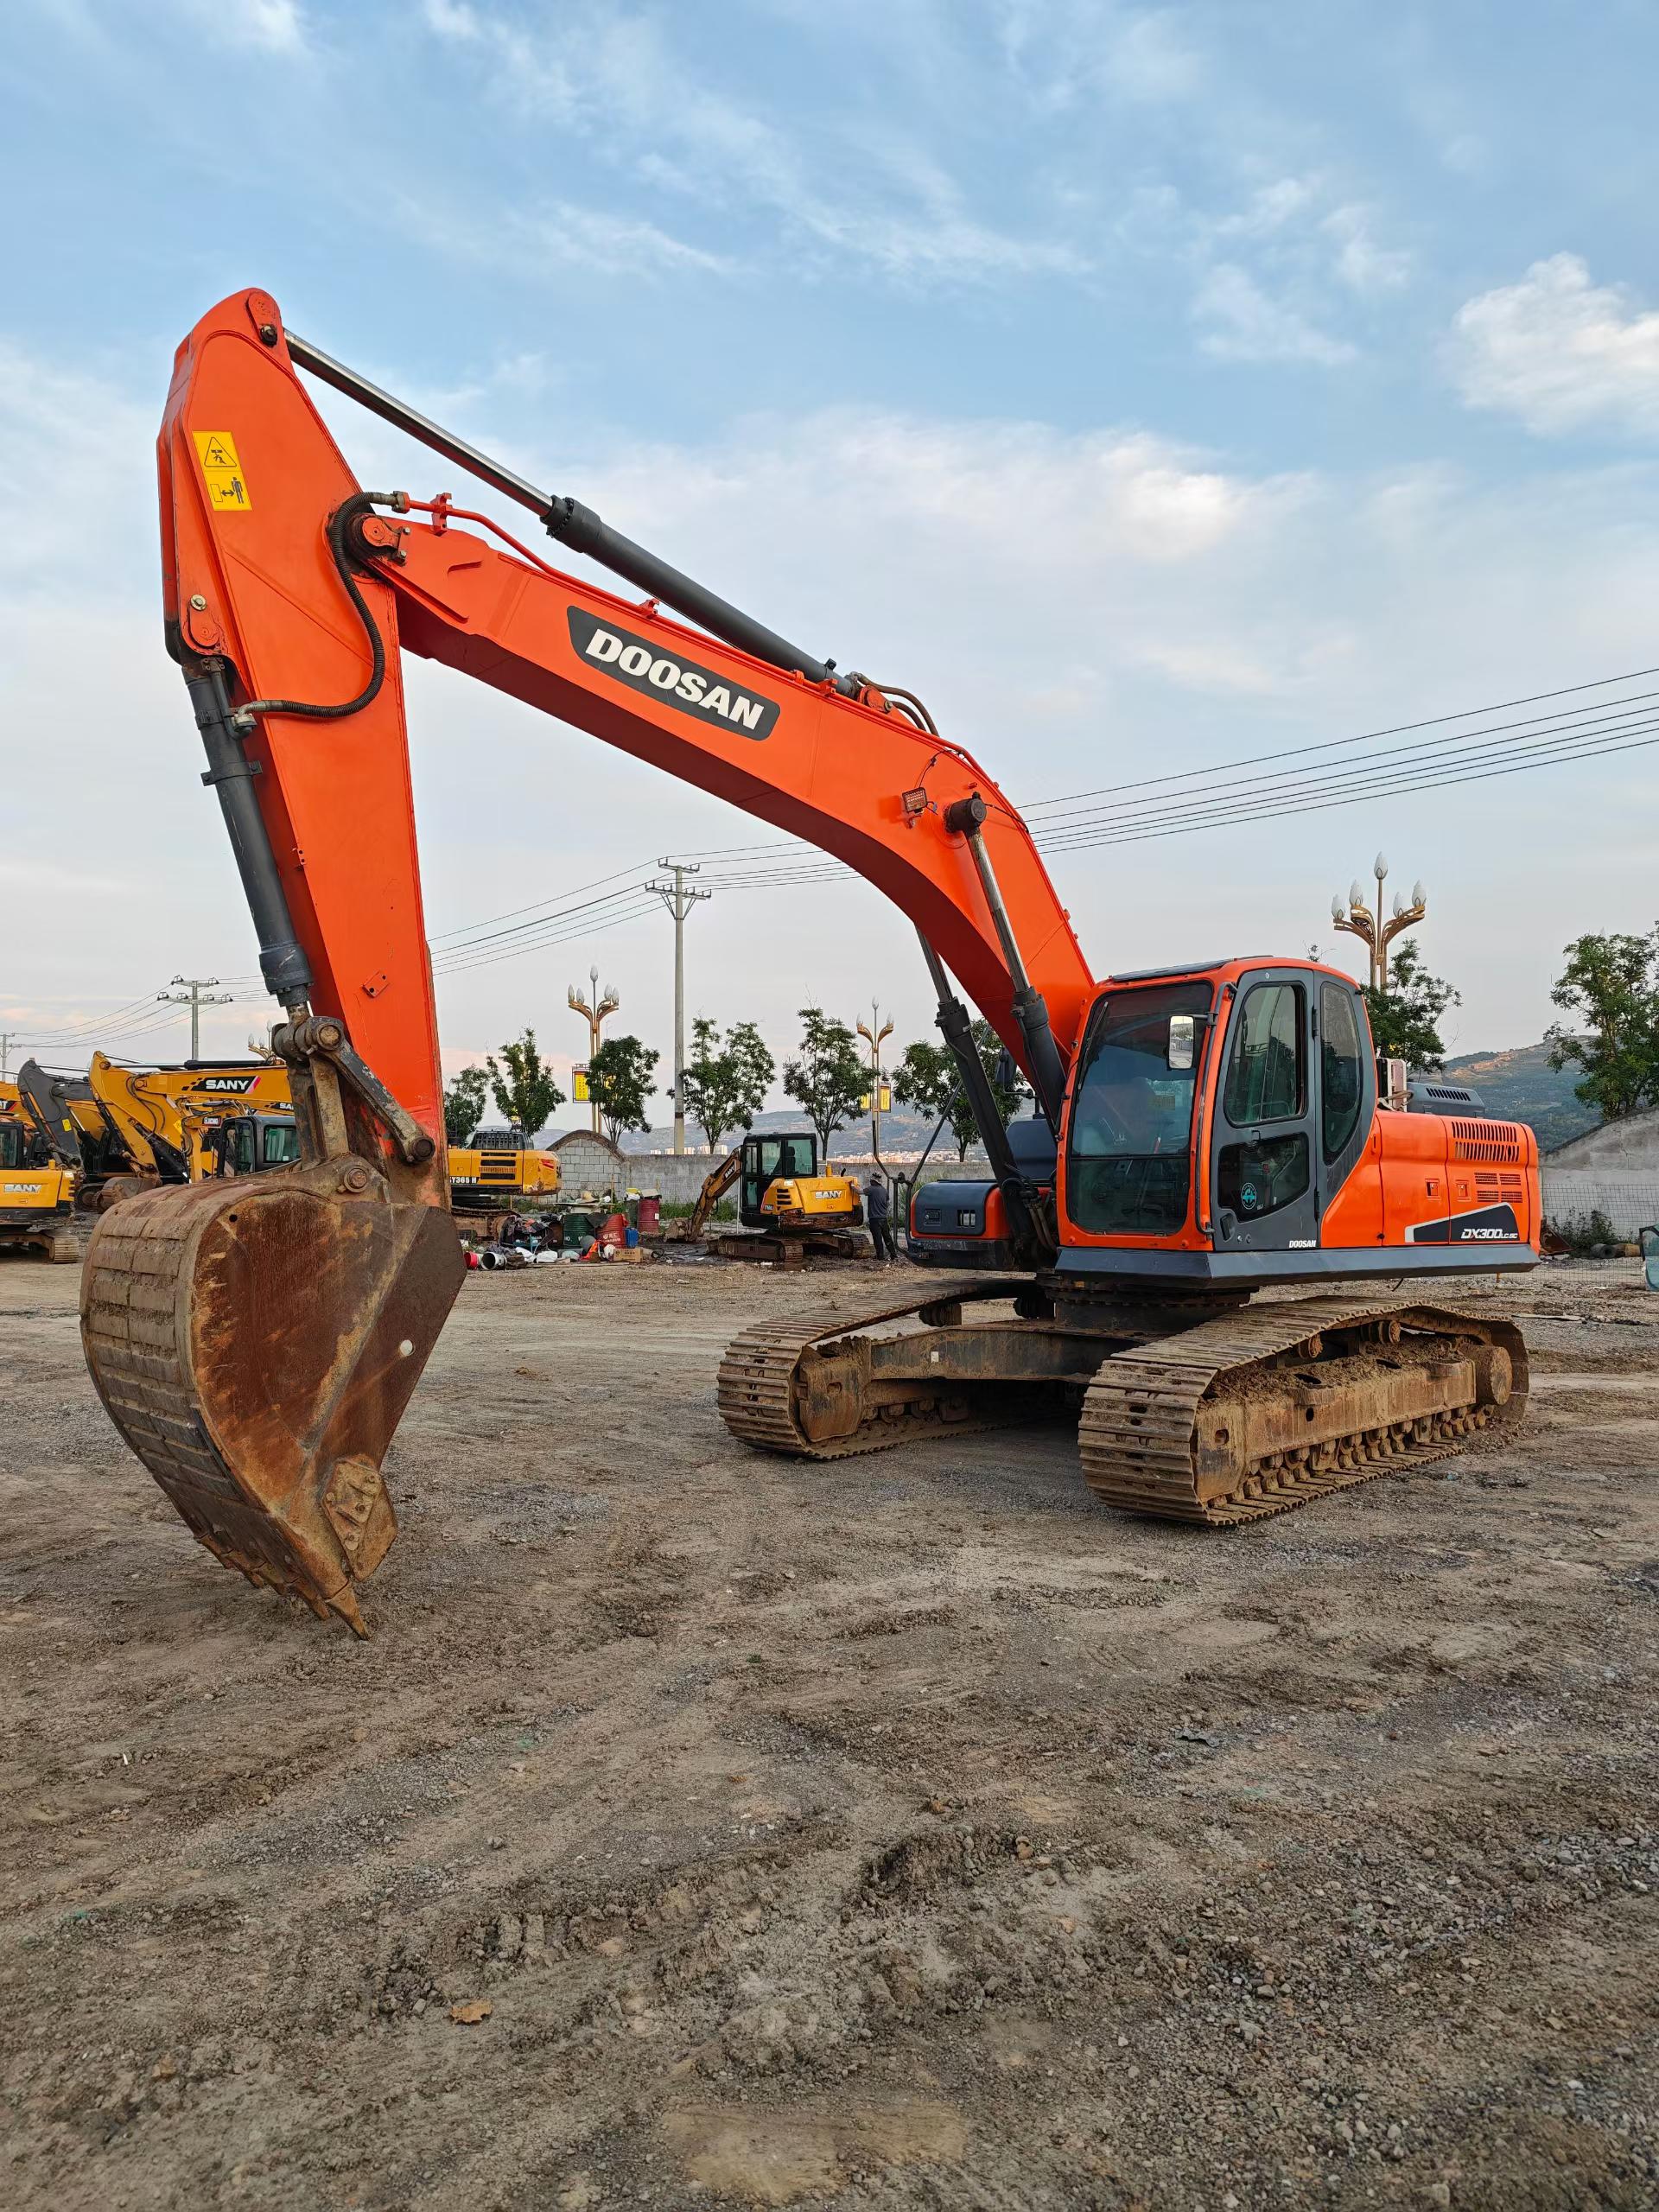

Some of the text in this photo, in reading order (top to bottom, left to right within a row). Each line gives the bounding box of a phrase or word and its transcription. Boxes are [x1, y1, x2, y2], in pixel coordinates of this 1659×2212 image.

[586, 628, 765, 730] DOOSAN
[205, 1079, 250, 1090] SANY
[3, 1184, 42, 1194] SANY
[815, 1190, 843, 1200] SANY
[1288, 1240, 1317, 1249] DOOSAN
